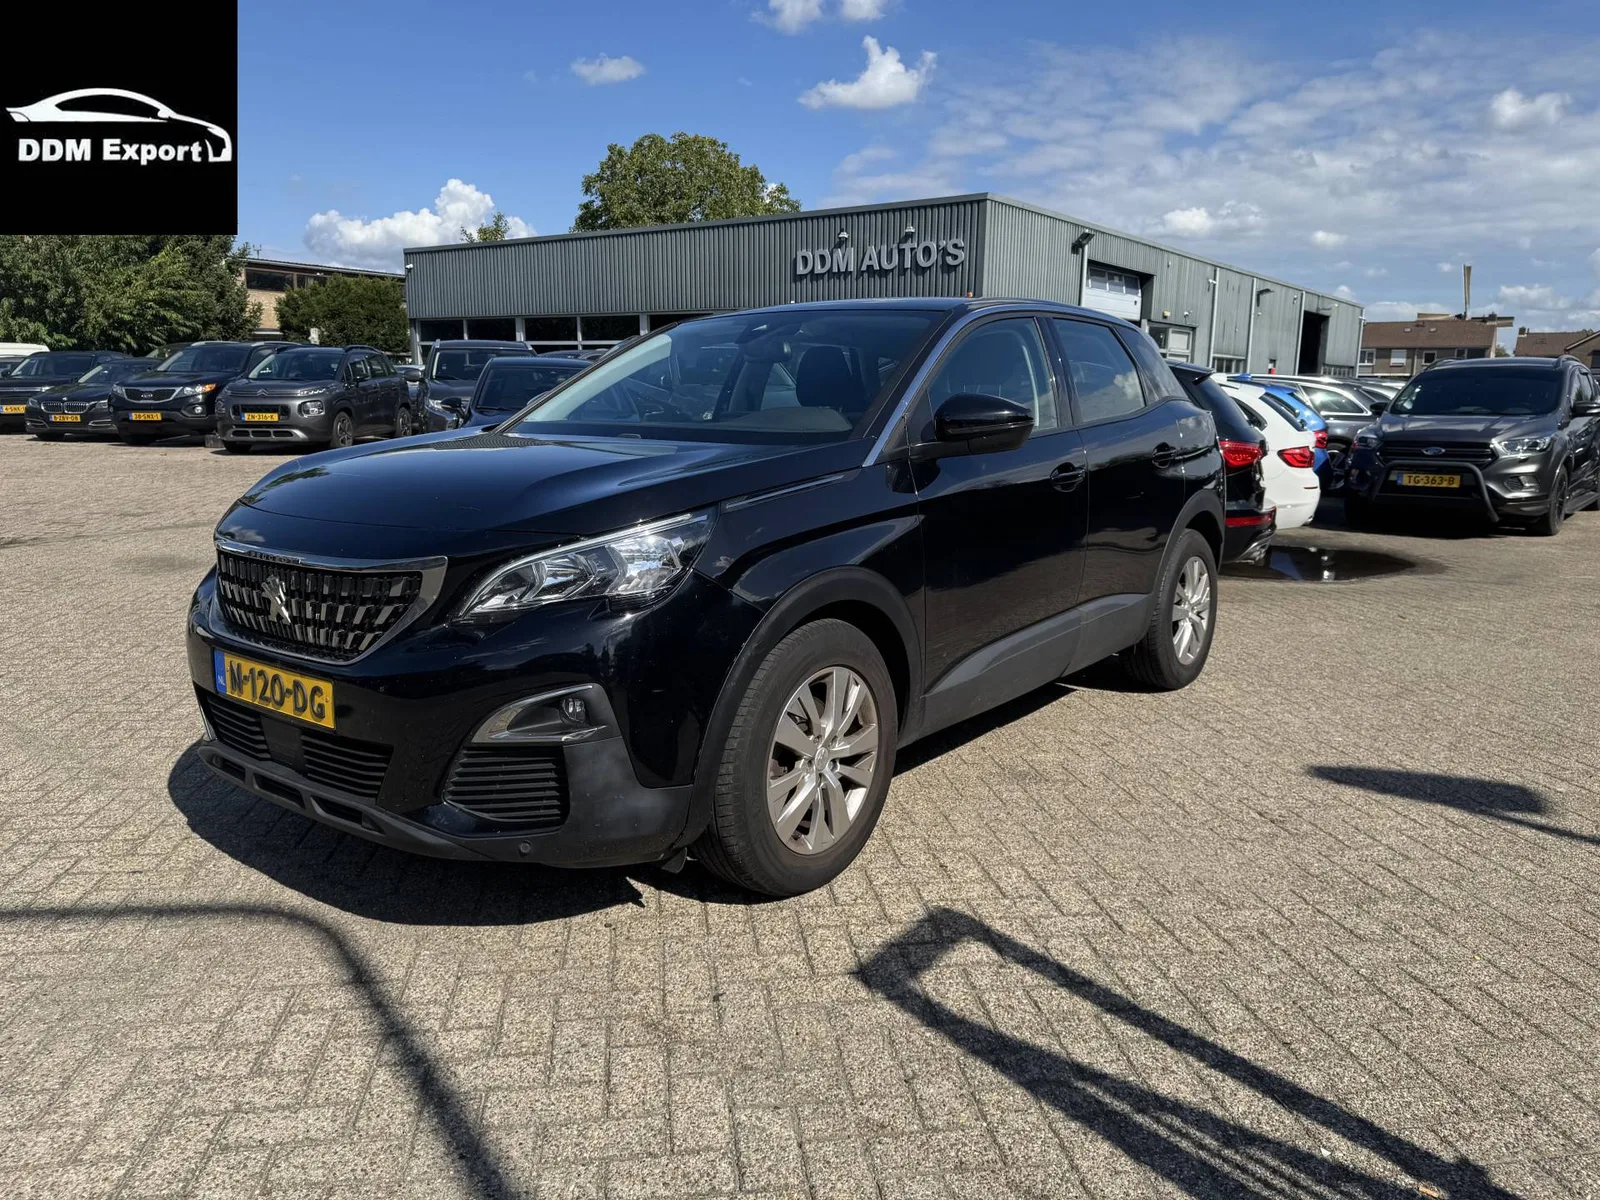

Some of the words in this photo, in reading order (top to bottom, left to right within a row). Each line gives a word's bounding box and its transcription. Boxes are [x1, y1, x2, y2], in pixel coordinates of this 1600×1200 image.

[796, 247, 854, 275] DDM
[860, 238, 966, 272] AUTO'S
[1407, 475, 1455, 486] TG-363-B
[229, 660, 326, 720] N-120-DG
